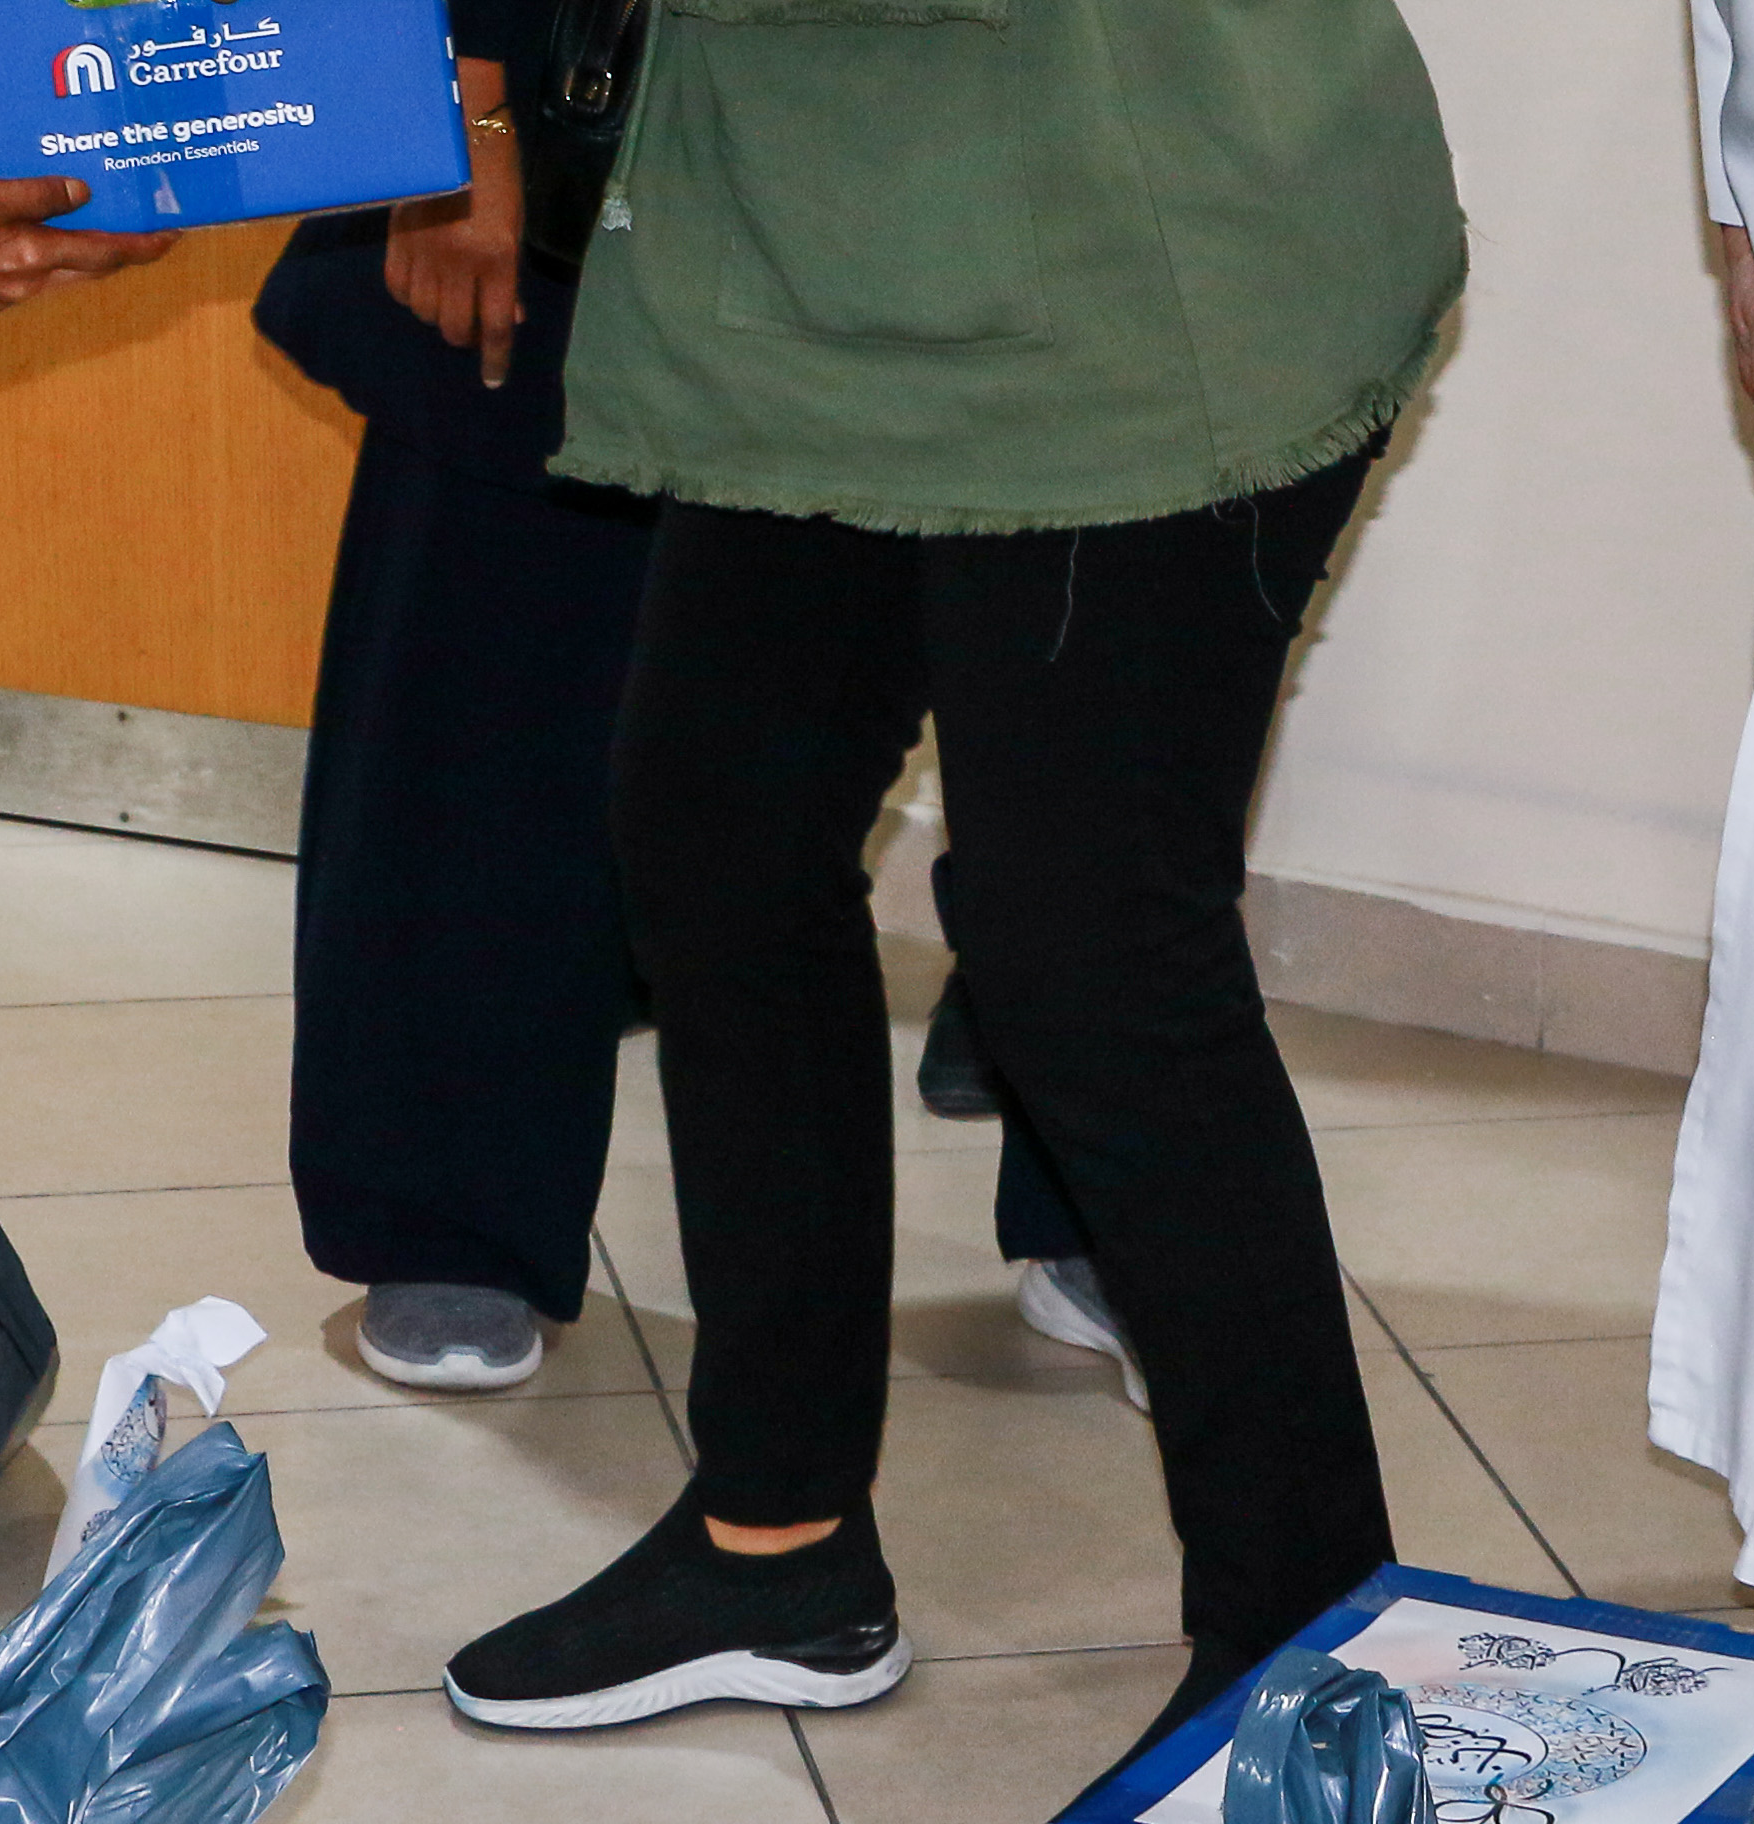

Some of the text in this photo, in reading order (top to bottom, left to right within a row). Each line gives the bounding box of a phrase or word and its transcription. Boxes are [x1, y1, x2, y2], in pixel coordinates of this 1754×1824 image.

[127, 17, 282, 60] كارفور
[128, 48, 285, 87] Carrefour
[39, 100, 316, 156] Share the generosity
[103, 138, 260, 171] Ramadan Essentials
